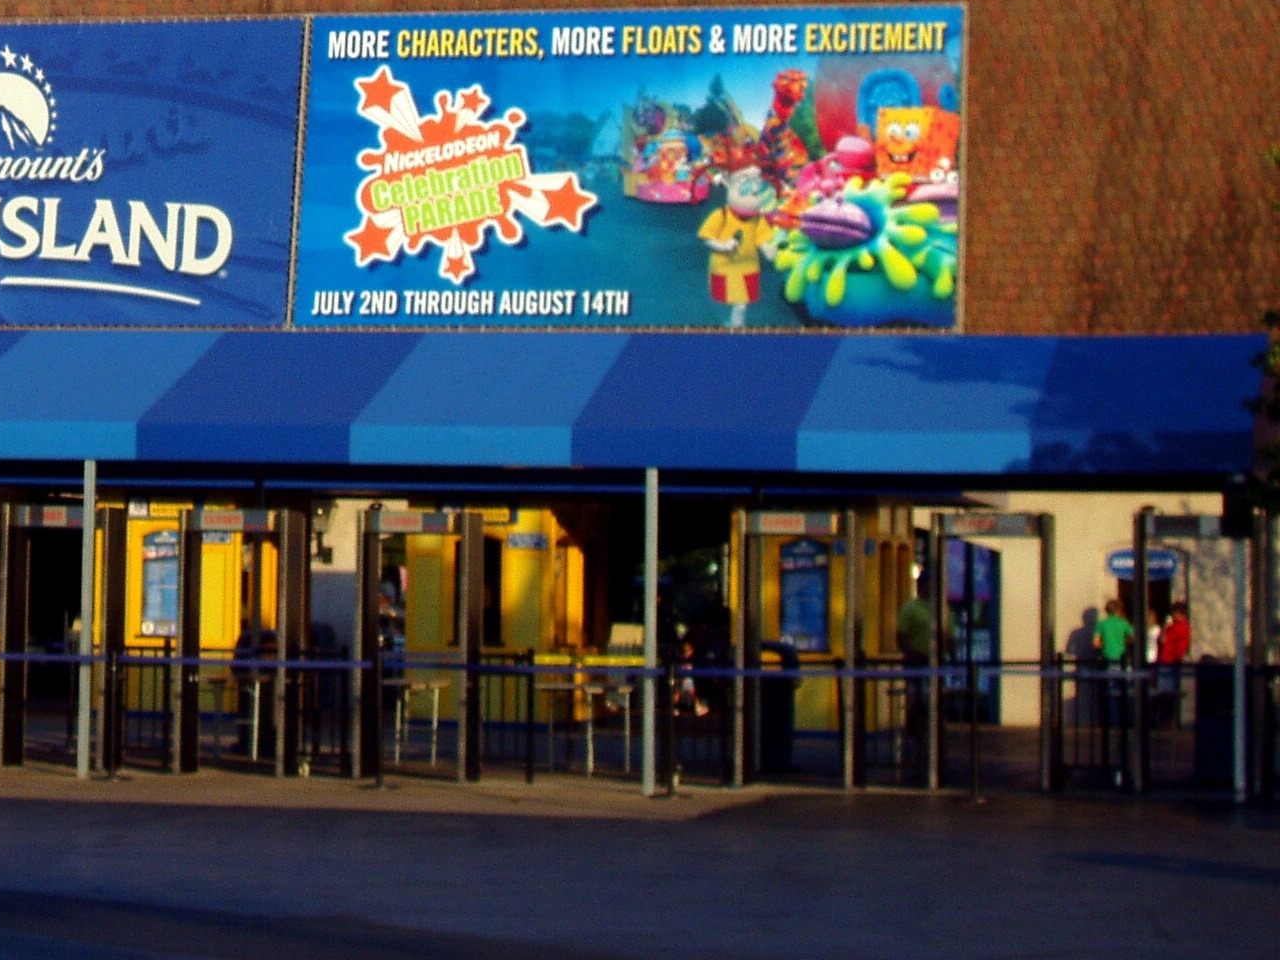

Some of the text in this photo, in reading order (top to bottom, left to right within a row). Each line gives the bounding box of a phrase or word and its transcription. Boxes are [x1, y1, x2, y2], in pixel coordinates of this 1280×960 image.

[328, 22, 947, 59] MORE CHARACTERS, MORE FLOATS & MORE EXCITEMENT
[384, 131, 500, 173] NICKELODEON
[372, 154, 522, 212] Celebration
[404, 185, 503, 235] PARADE
[311, 291, 629, 316] JULY 2ND THROUGH AUGUST 14TH
